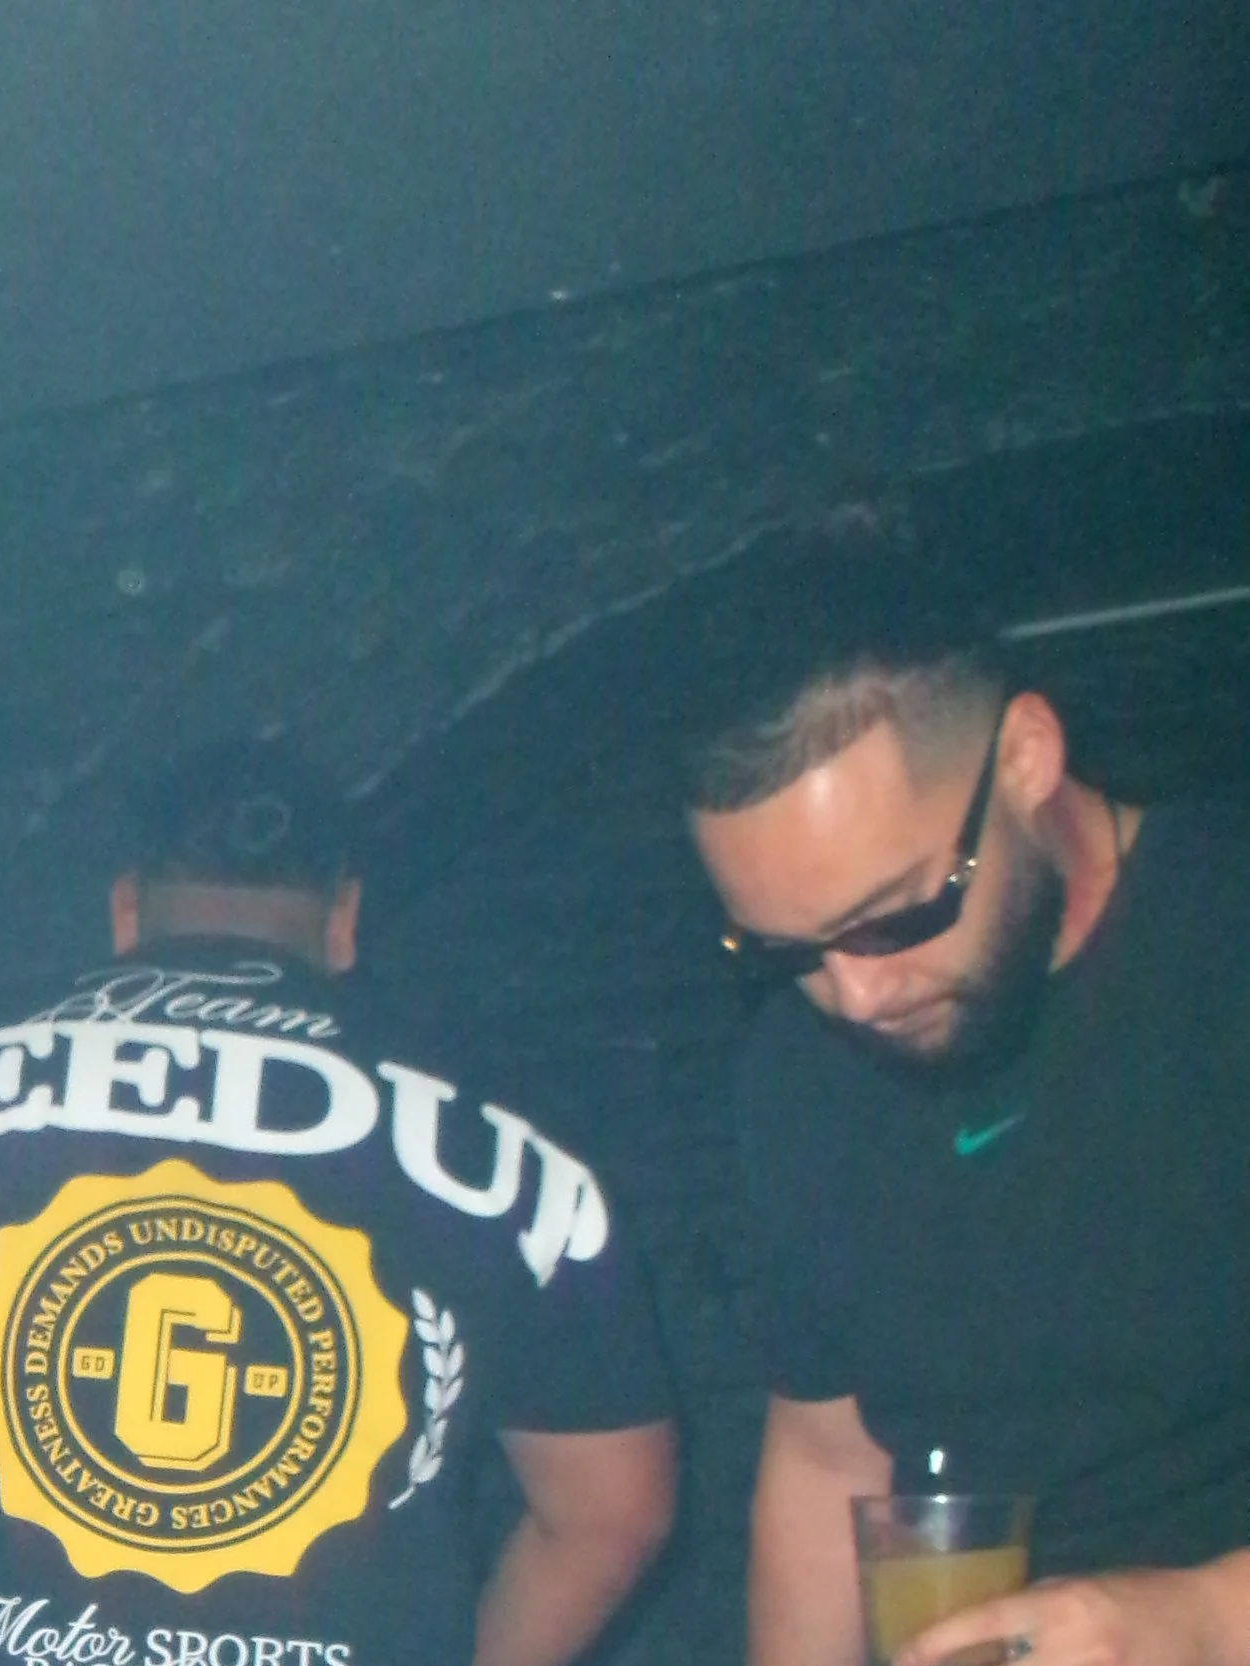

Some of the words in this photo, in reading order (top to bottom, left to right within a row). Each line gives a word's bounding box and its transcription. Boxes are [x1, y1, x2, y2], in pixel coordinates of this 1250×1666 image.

[26, 960, 341, 1038] Team
[25, 1232, 124, 1376] DEMANDS
[129, 1217, 323, 1324] UNDISPUTED
[114, 1271, 242, 1472] G
[171, 1328, 334, 1530] PERFORMANCES
[25, 1384, 160, 1528] GREATNESS
